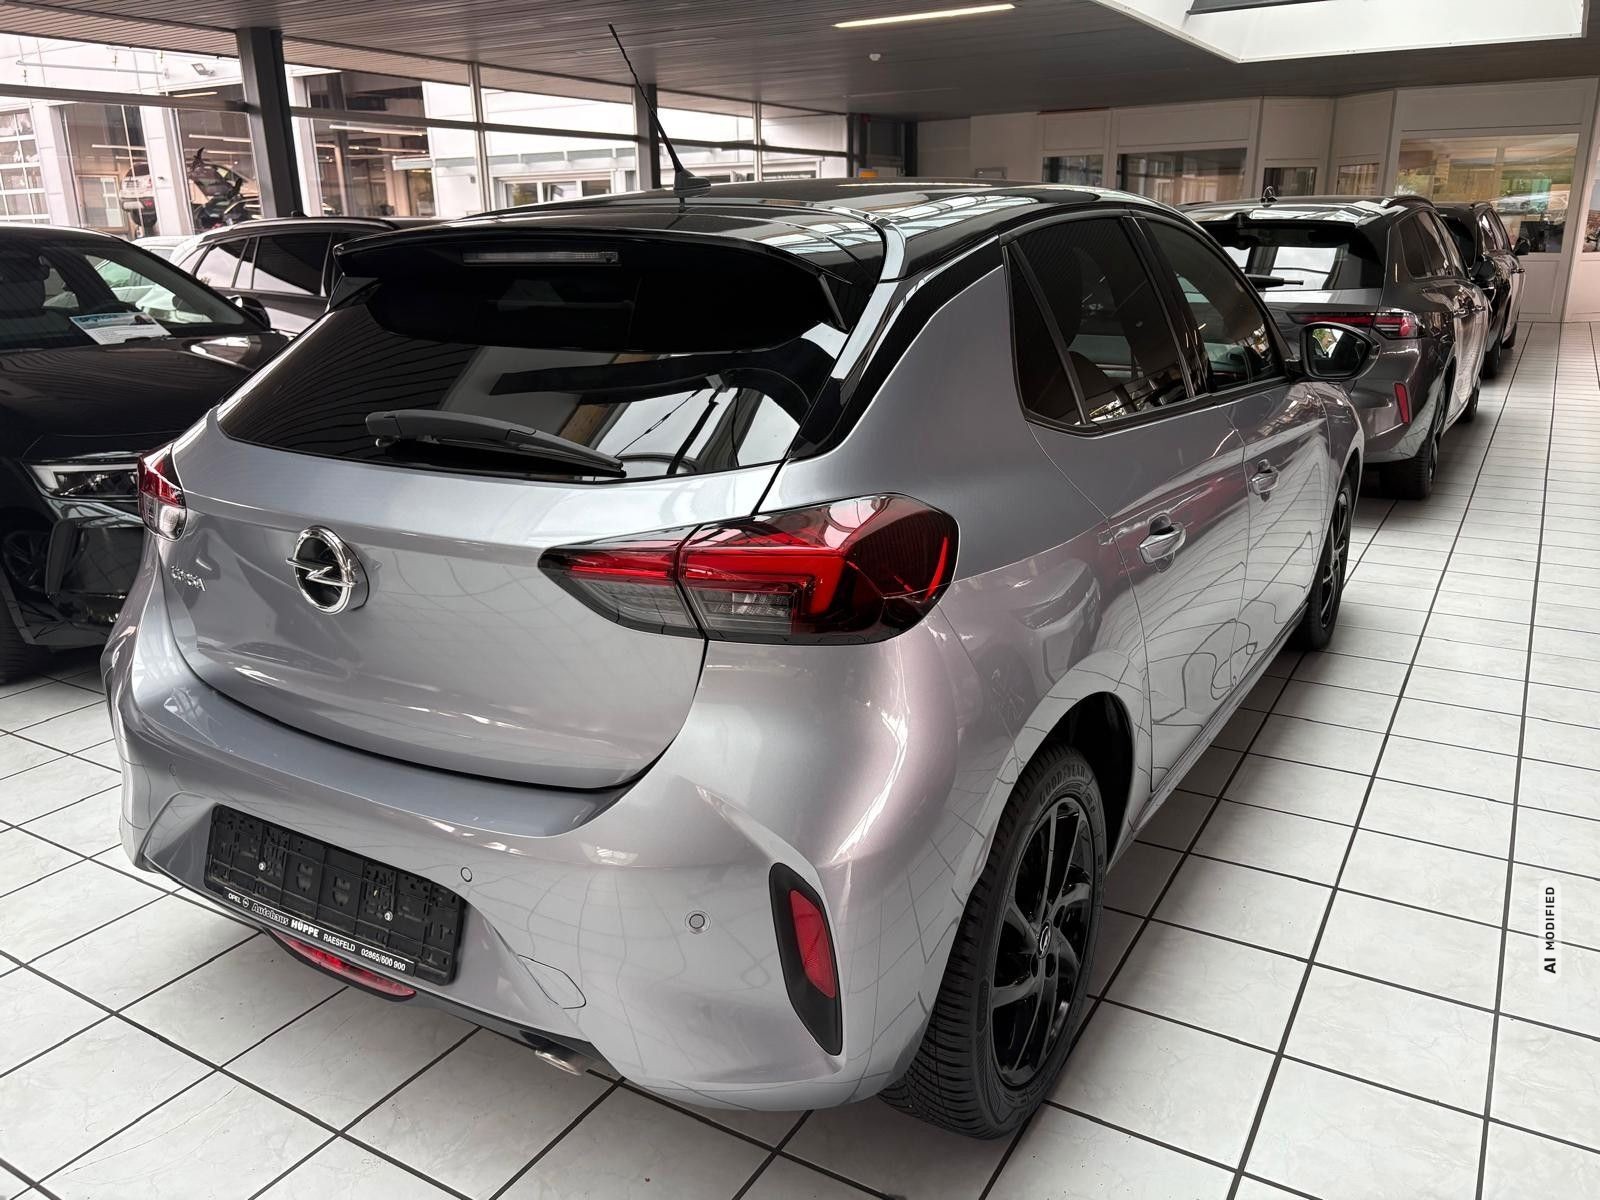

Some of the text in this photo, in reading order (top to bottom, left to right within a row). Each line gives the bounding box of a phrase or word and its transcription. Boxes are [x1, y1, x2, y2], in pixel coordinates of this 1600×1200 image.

[228, 893, 406, 972] OPEL Autohaus HÜPPE RAESFELD 02865/600 900
